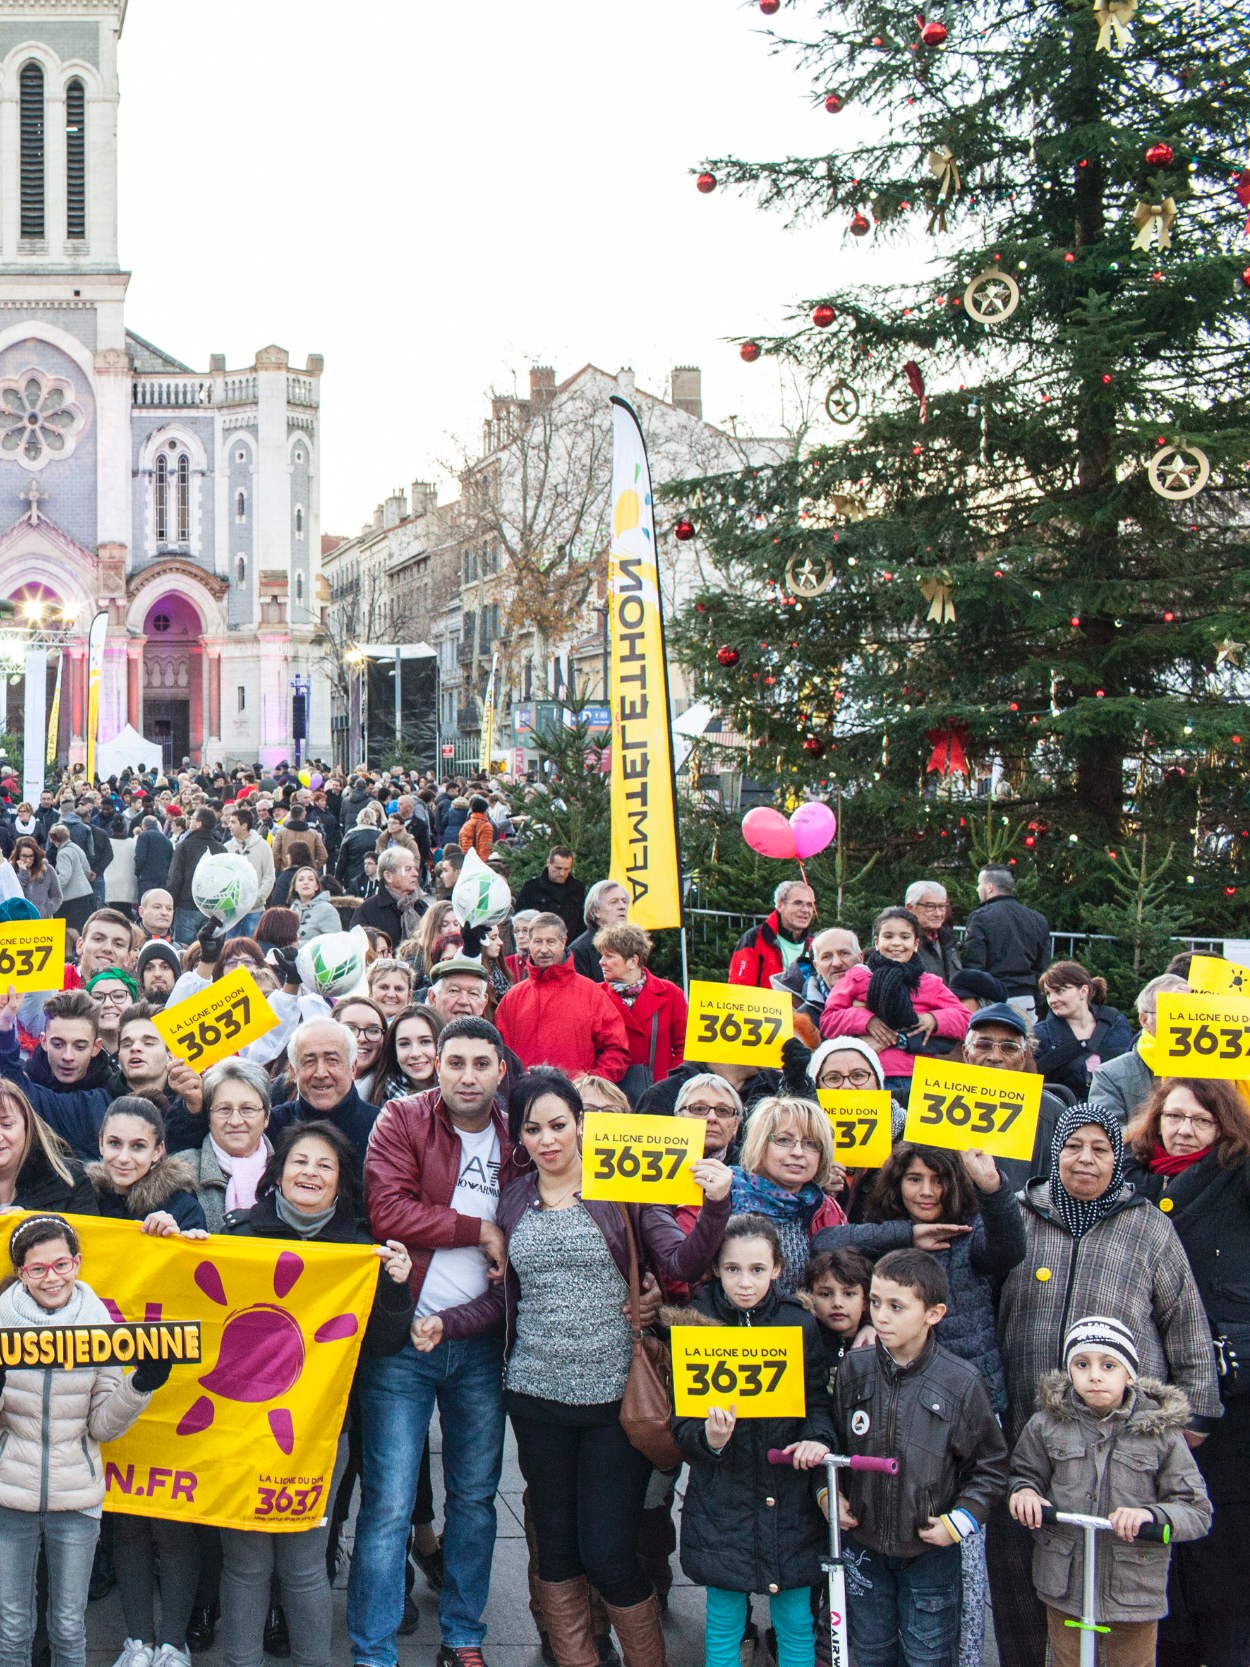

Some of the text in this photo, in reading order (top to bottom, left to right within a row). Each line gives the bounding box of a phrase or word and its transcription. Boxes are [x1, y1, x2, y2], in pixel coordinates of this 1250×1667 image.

[169, 987, 245, 1034] LA LIGNE DU DON
[700, 1000, 782, 1015] LA LIGNE DU DON
[1169, 1012, 1185, 1020] LA
[1188, 1013, 1221, 1021] LIGNE
[1224, 1014, 1239, 1022] DU
[177, 995, 250, 1062] 3637
[697, 1013, 782, 1047] 3637
[925, 1078, 1025, 1101] LA LIGNE DU DON
[919, 1093, 1023, 1133] 3637
[595, 1133, 689, 1145] LA LIGNE DU DON
[836, 1118, 878, 1148] 37
[594, 1146, 687, 1182] 3637
[685, 1348, 787, 1357] LA LIGNE DU DON
[686, 1360, 788, 1397] 3637
[259, 1474, 272, 1482] LA
[274, 1476, 296, 1485] LIGNE
[254, 1485, 323, 1515] 3637
[831, 1628, 841, 1667] AIRW
